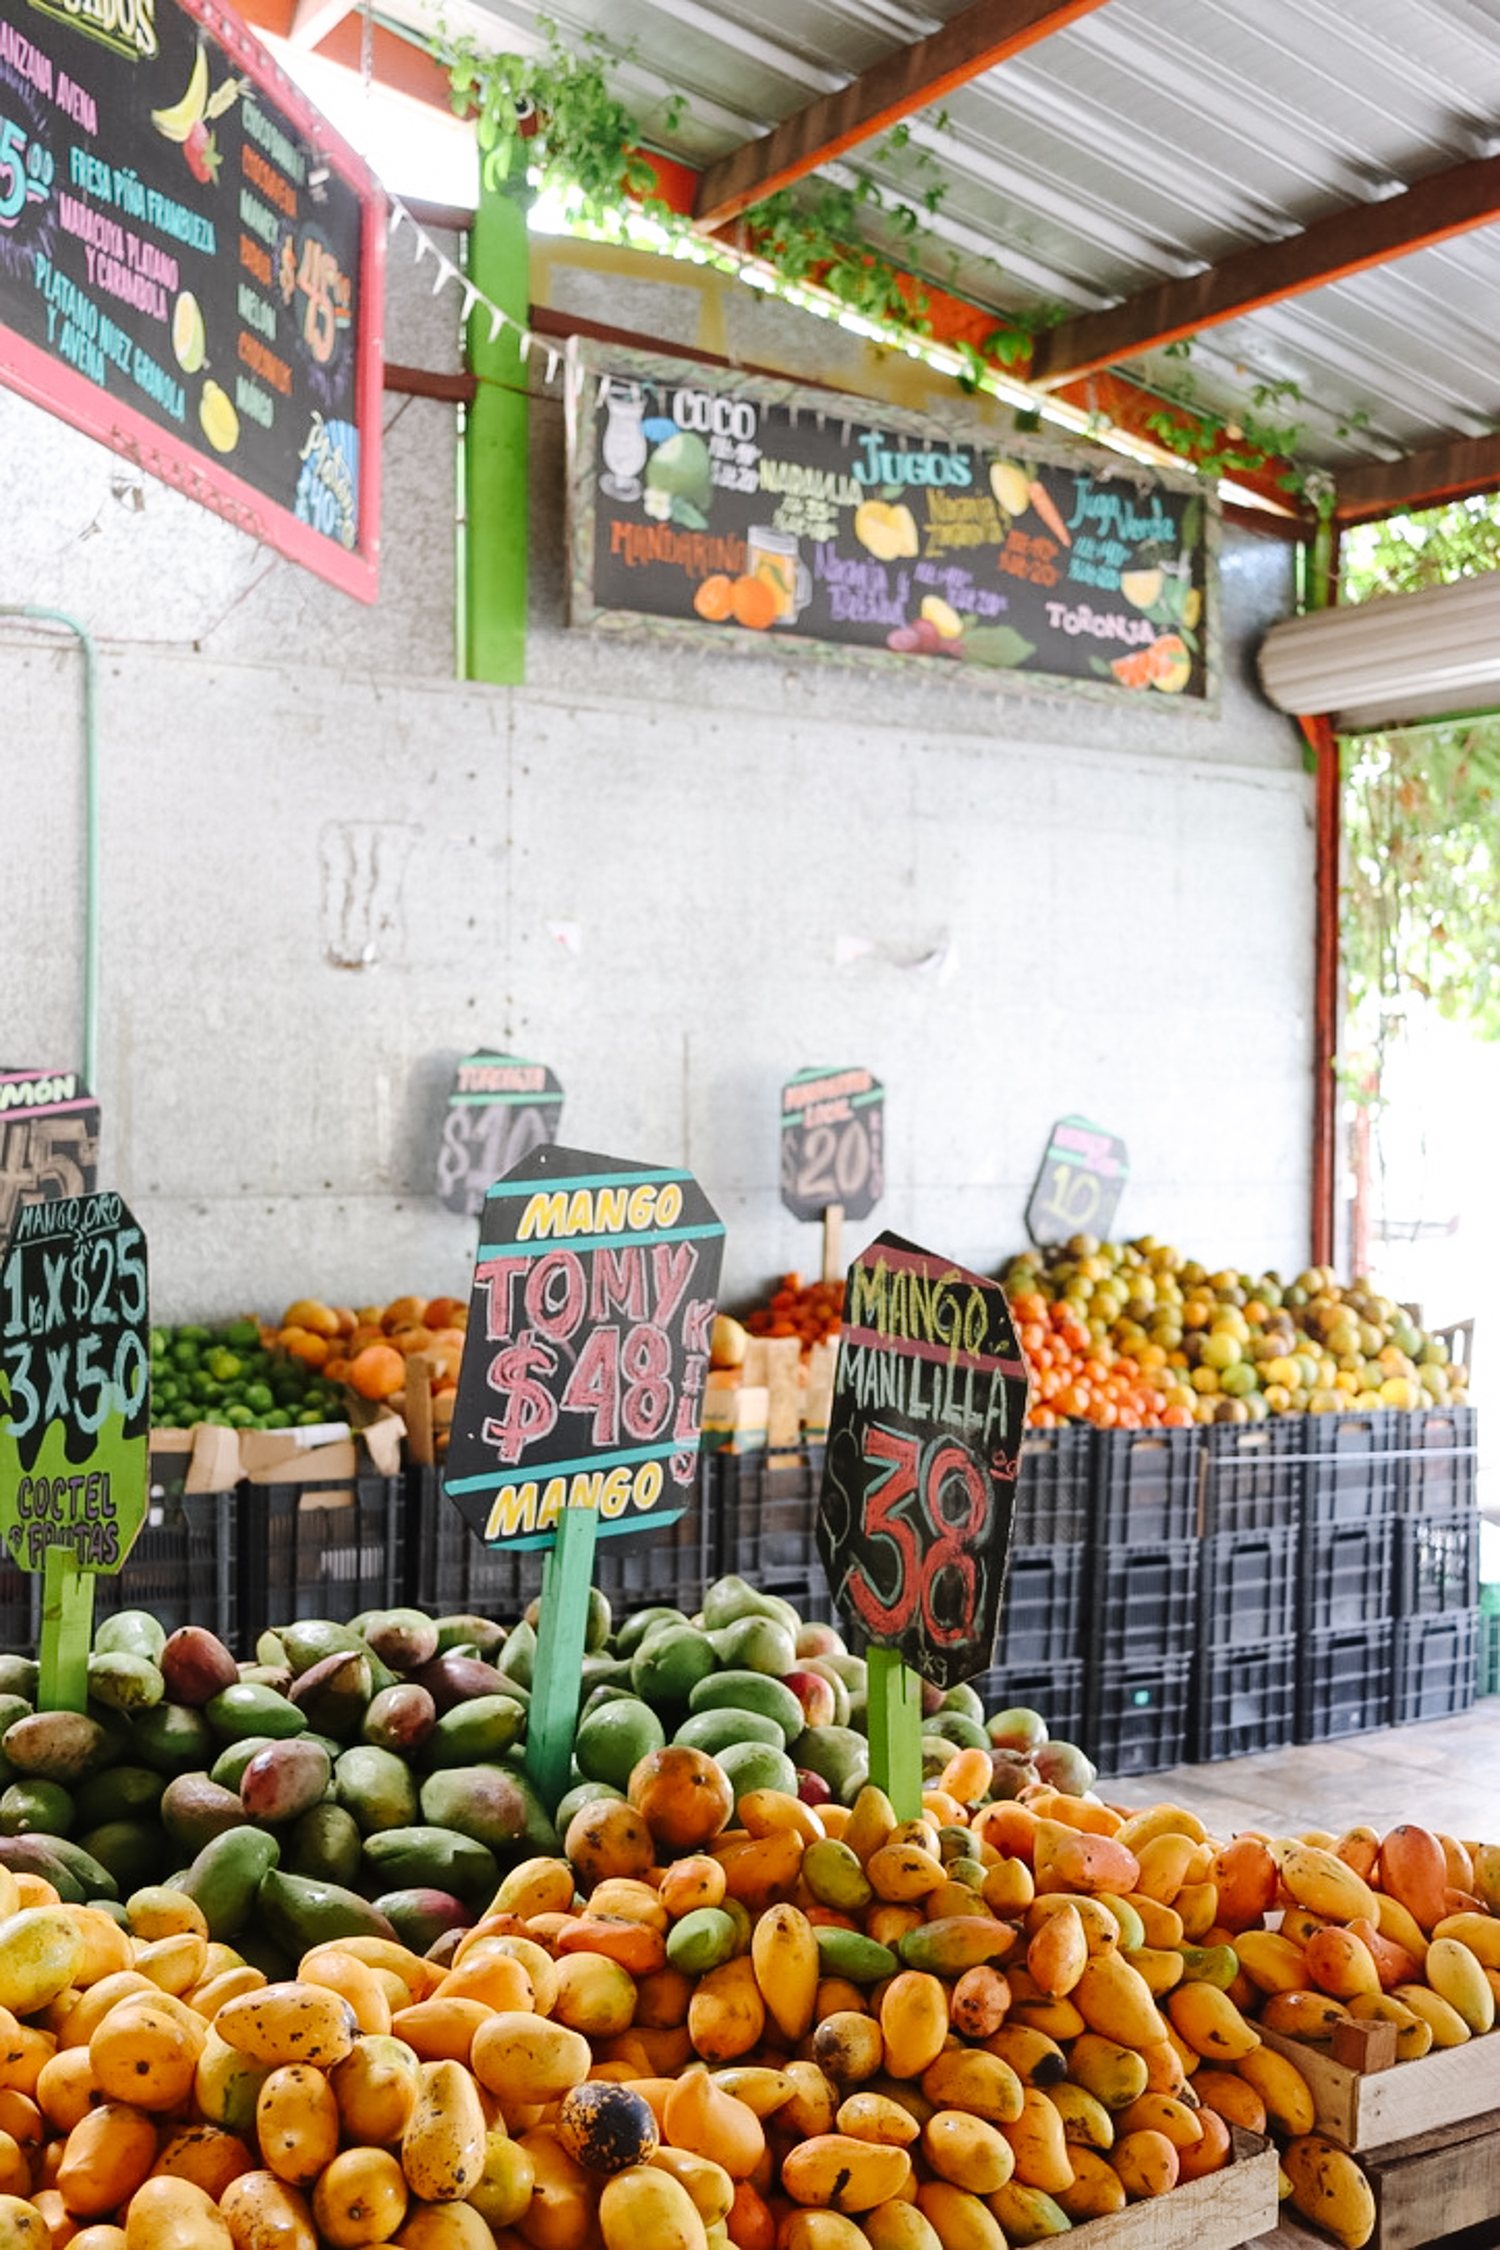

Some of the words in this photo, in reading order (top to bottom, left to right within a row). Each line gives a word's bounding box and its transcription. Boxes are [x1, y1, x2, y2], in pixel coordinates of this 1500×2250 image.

[55, 71, 98, 137] AVENA
[69, 146, 112, 203] FRESA
[35, 251, 98, 341] PLATANO
[85, 245, 97, 285] Y
[47, 303, 58, 345] Y
[59, 319, 106, 388] AVENA
[673, 388, 757, 442] COCO
[17, 1196, 80, 1240] MANGO
[83, 1193, 122, 1227] ORO
[516, 1182, 683, 1241] MANGO
[474, 1240, 699, 1344] TOMY
[482, 1324, 674, 1465] $48
[17, 1471, 117, 1522] COCTEL
[484, 1460, 664, 1541] MANGO
